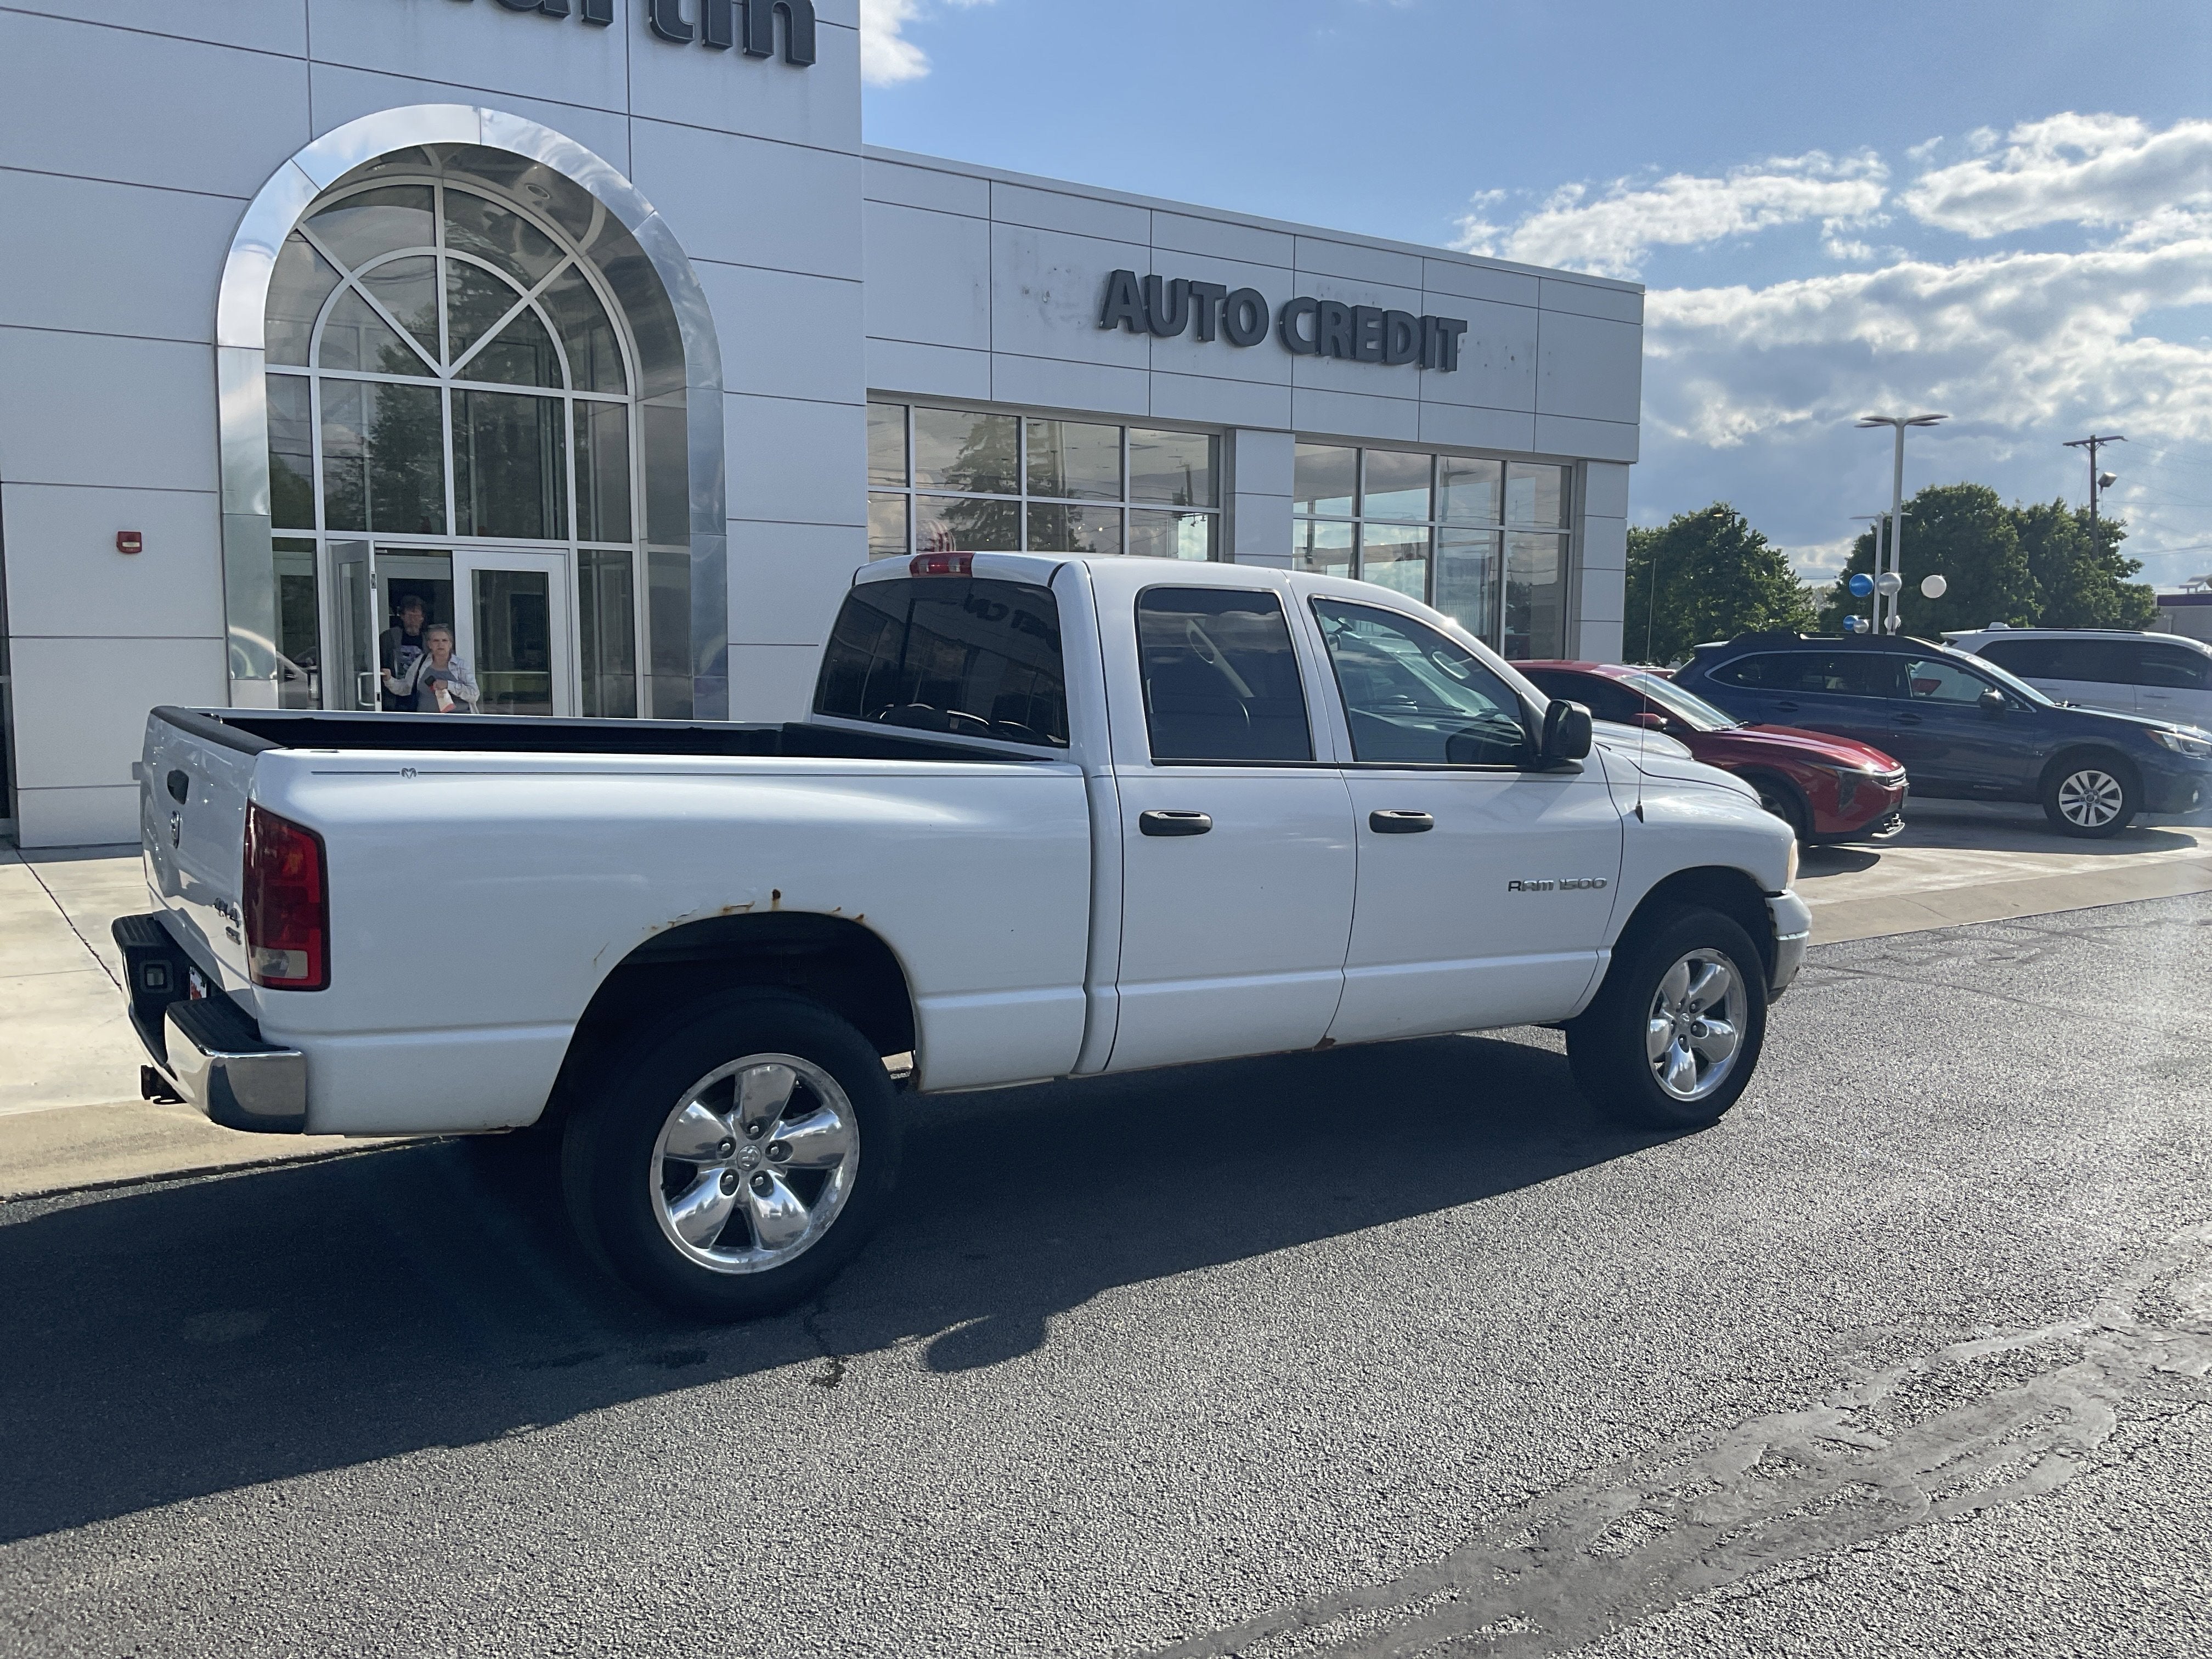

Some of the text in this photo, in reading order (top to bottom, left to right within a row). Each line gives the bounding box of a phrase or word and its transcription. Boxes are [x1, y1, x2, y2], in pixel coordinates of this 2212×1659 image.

[1099, 269, 1468, 372] AUTO CREDIT
[1559, 877, 1607, 890] 1500
